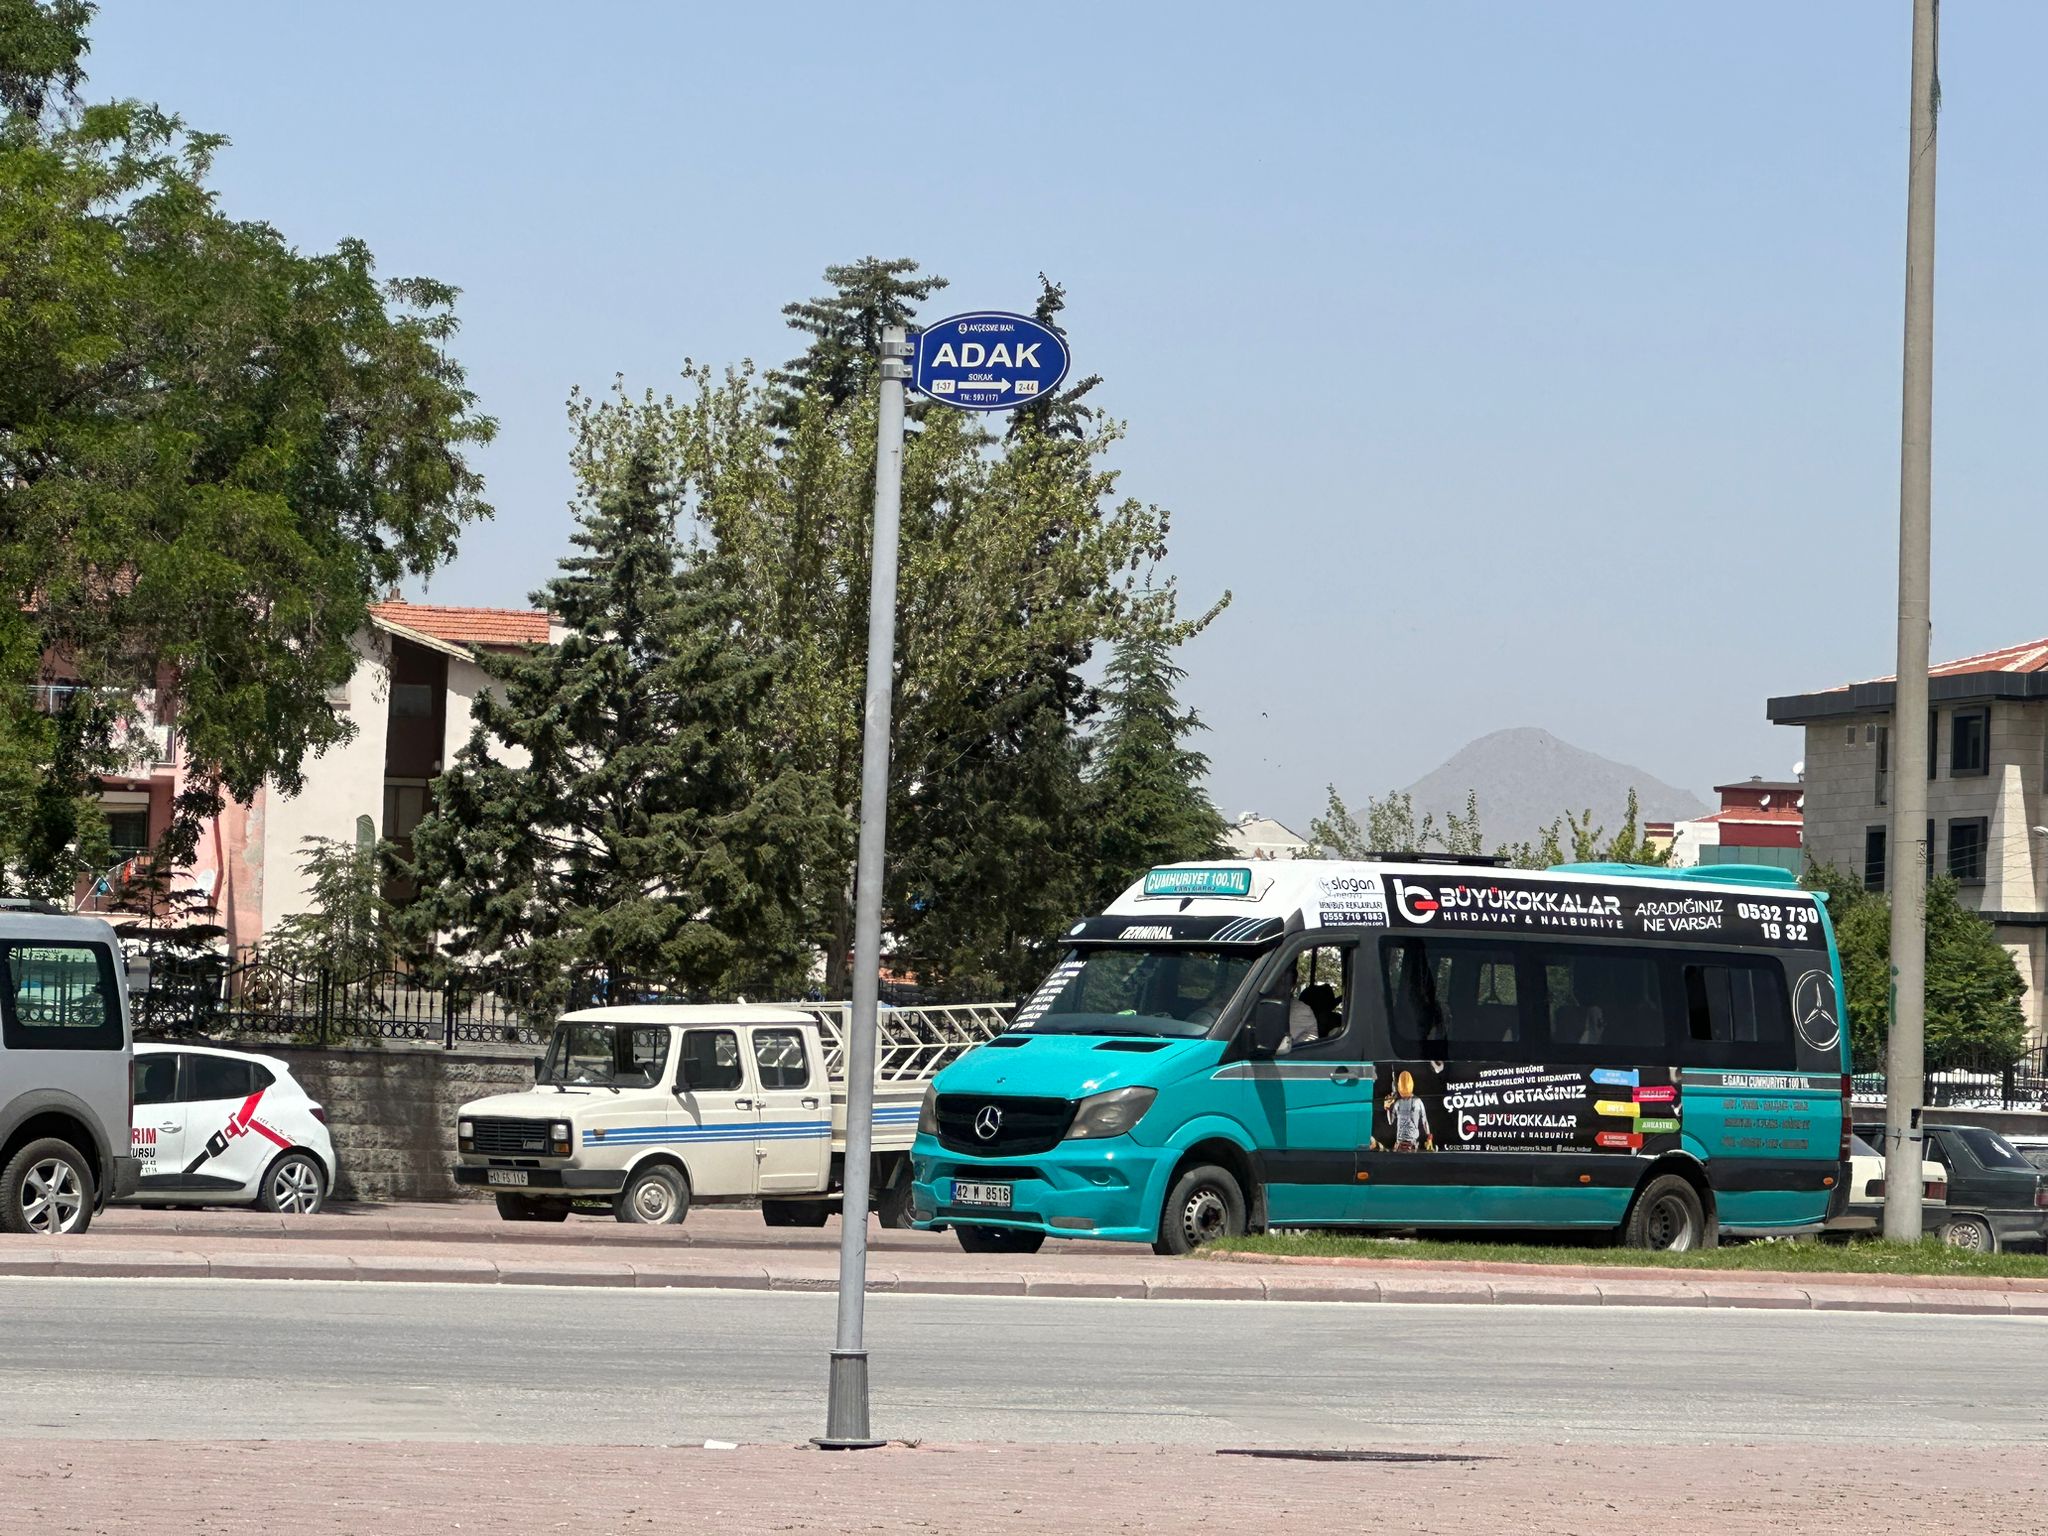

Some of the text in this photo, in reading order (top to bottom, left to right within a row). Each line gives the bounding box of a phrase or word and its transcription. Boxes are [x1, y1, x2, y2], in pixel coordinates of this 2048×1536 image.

[931, 343, 1041, 368] ADAK
[968, 373, 993, 381] SOKAK
[936, 382, 951, 390] 1-37
[1018, 383, 1034, 392] 2-44
[986, 394, 999, 402] (17)
[1331, 876, 1375, 892] slogan
[1439, 885, 1621, 916] BÜYÜKOKKALAR
[1635, 898, 1724, 916] ARADIĞINIZ
[1323, 912, 1344, 921] 0555
[1443, 911, 1624, 930] HIRDAVAT & NALBURİYE
[1737, 903, 1818, 924] 0532 730
[1643, 915, 1722, 932] NE VARSA!
[1761, 922, 1808, 941] 19 32
[1443, 1085, 1587, 1113] ÇÖZÜM ORTAĞINIZ
[1478, 1113, 1578, 1128] BÜYÜKOKKALAR
[1477, 1131, 1517, 1139] HIRDAVAT
[957, 1184, 968, 1198] 42
[985, 1186, 1010, 1201] 8516
